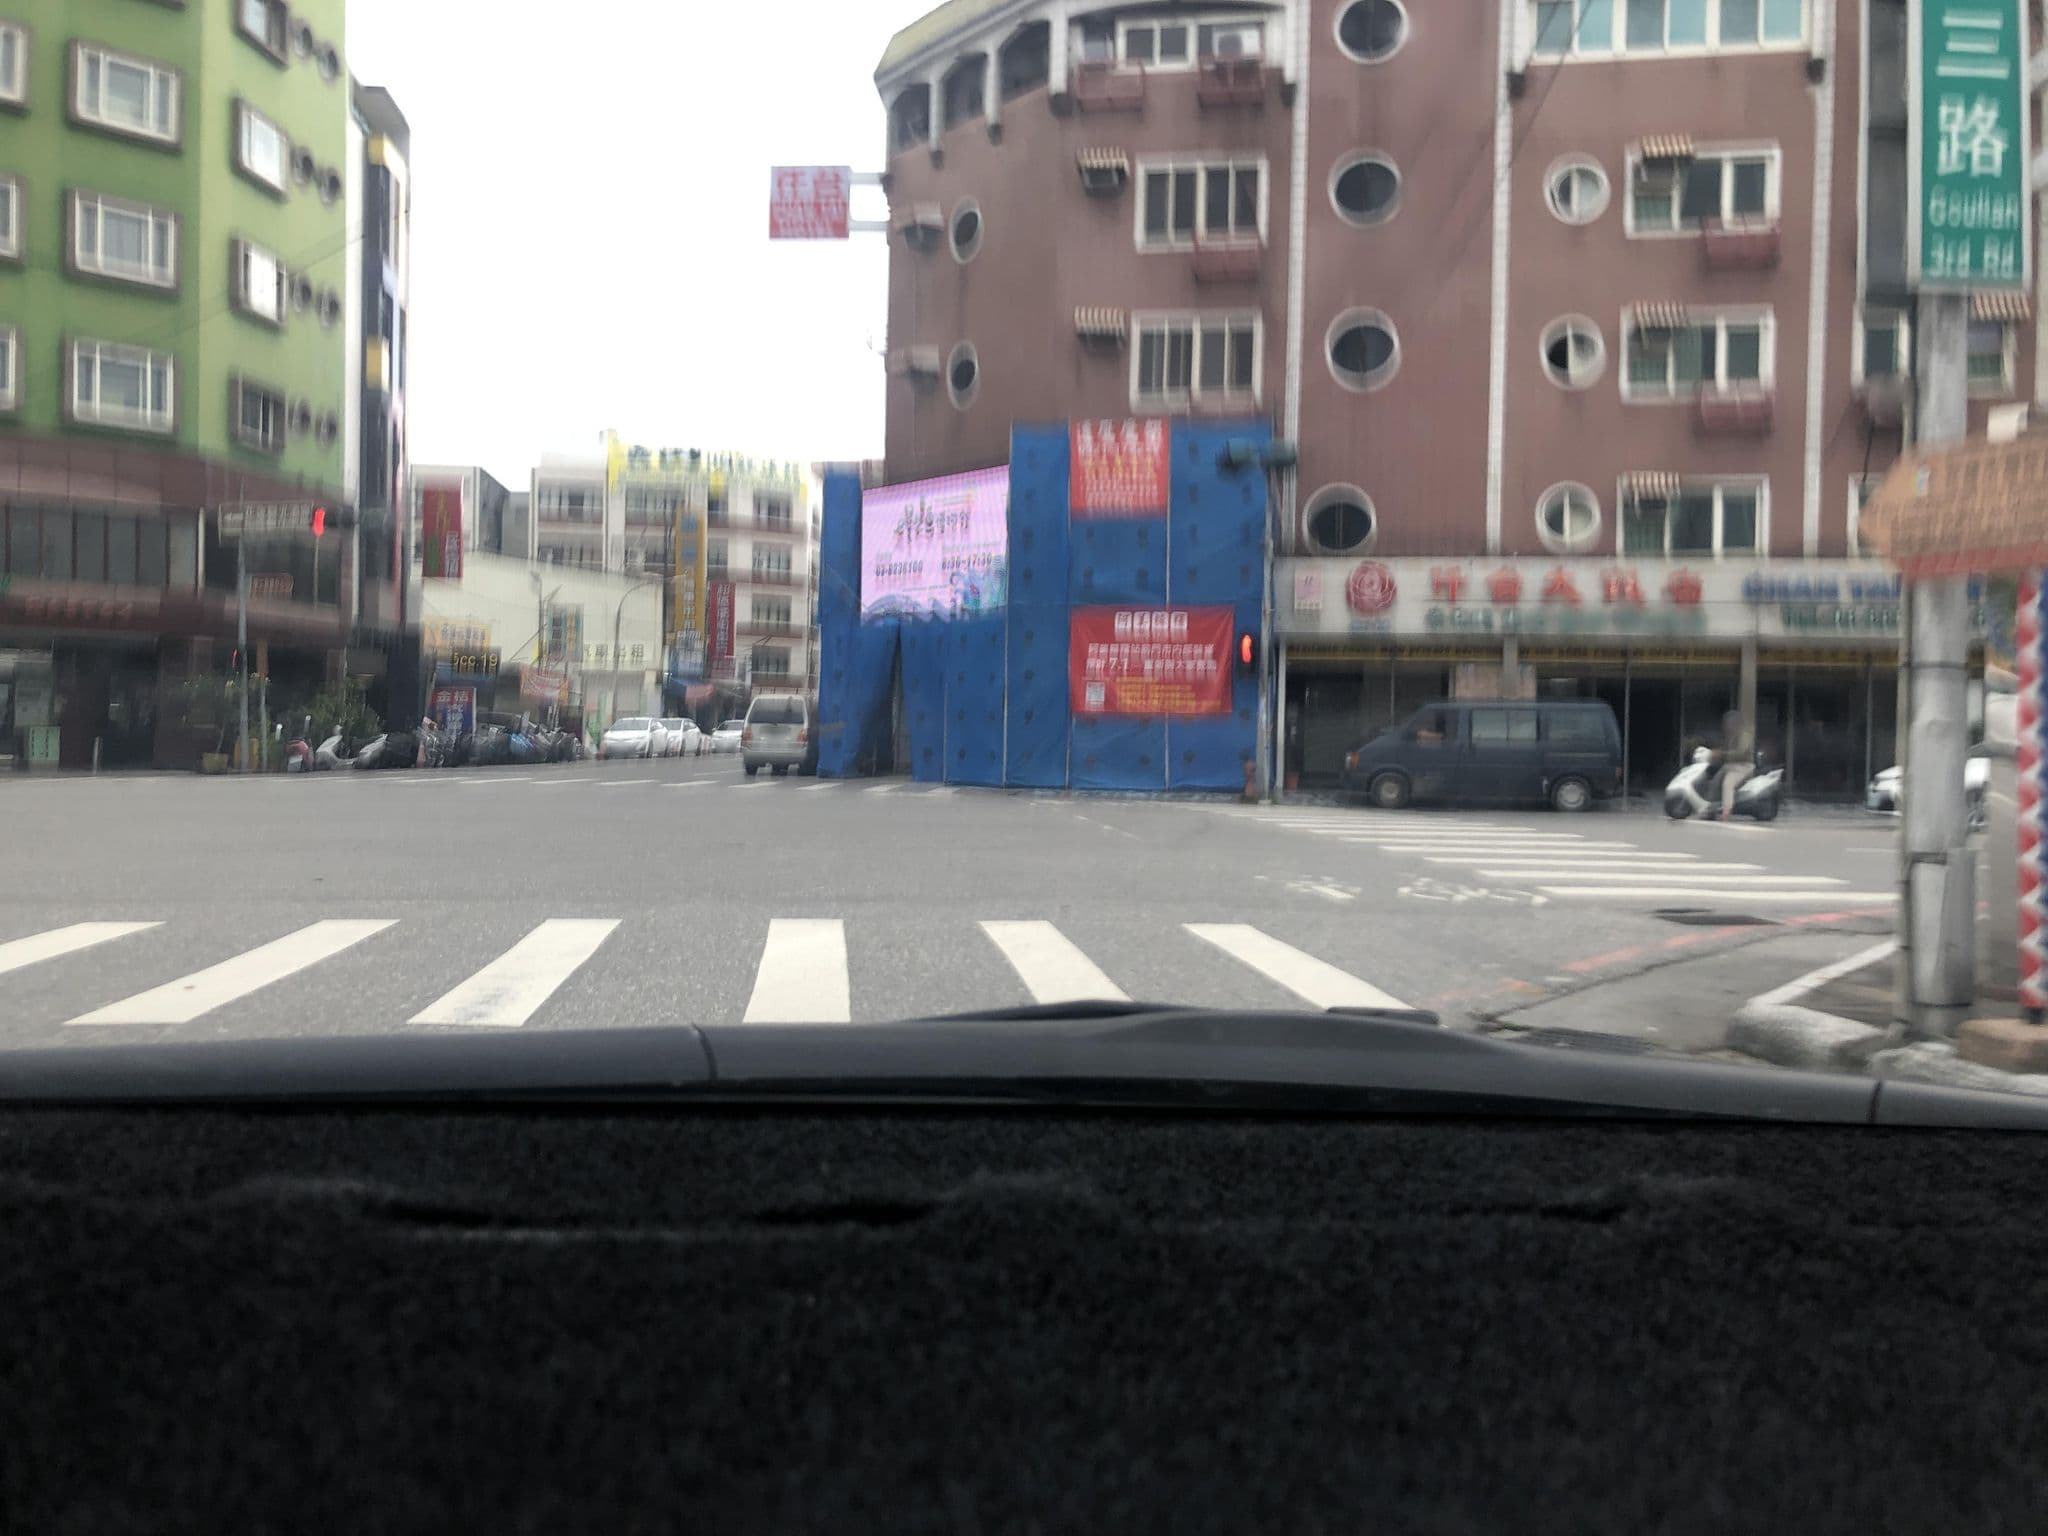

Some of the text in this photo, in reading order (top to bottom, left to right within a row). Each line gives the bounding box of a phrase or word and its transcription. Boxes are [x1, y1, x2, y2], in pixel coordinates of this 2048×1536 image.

[1936, 9, 2010, 178] 三路
[1929, 232, 2015, 278] 3rd Rd
